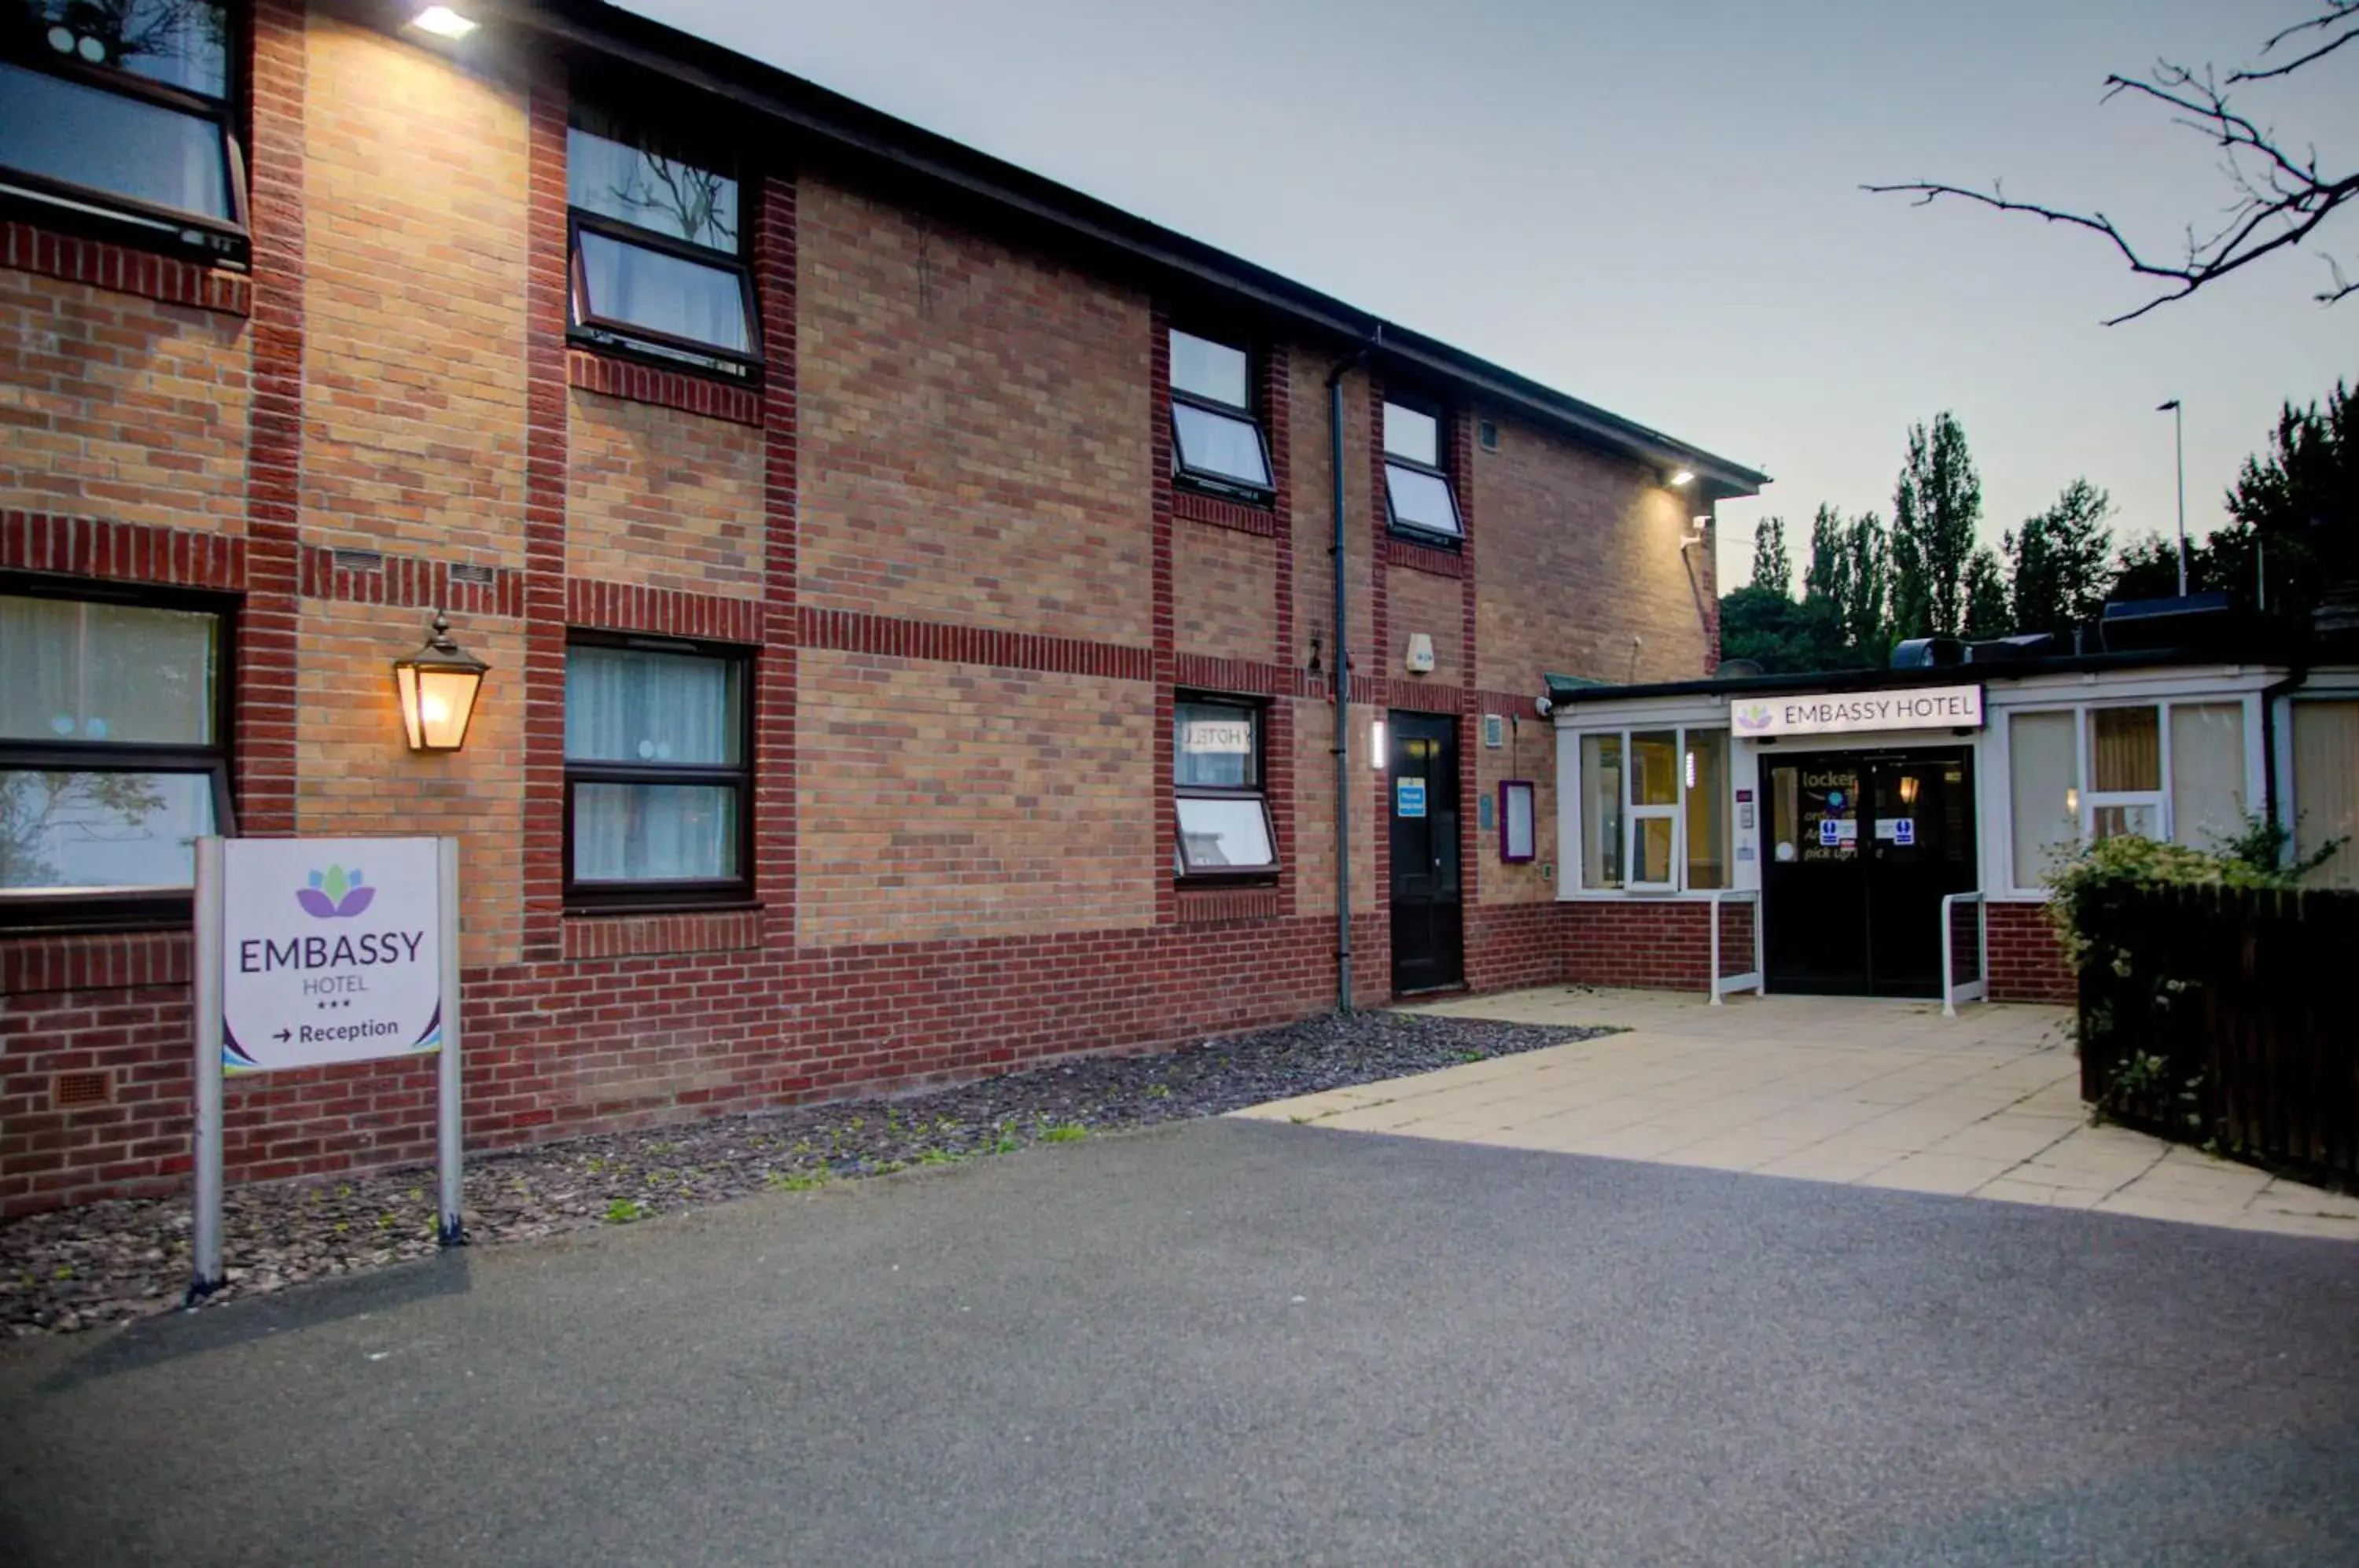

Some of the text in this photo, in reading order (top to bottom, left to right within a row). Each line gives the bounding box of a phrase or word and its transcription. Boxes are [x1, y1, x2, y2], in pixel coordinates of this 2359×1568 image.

[1786, 696, 1974, 724] EMBASSY HOTEL
[1802, 770, 1857, 788] locker
[241, 931, 424, 973] EMBASSY
[303, 975, 370, 996] HOTEL
[300, 1019, 399, 1043] Reception
